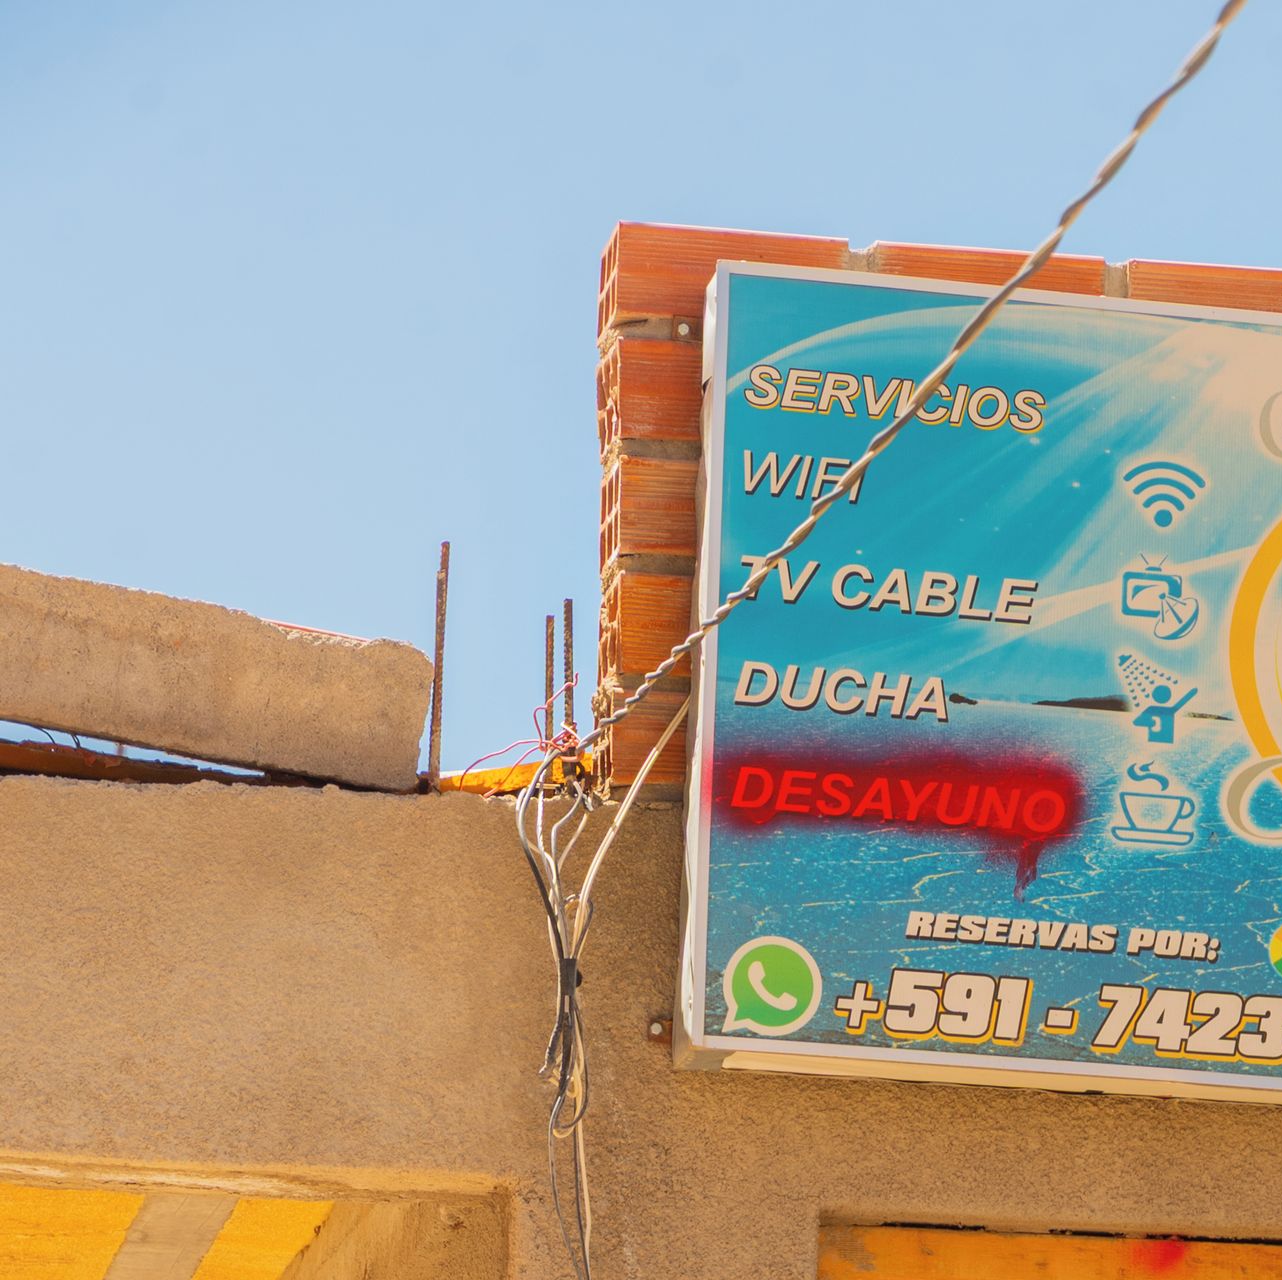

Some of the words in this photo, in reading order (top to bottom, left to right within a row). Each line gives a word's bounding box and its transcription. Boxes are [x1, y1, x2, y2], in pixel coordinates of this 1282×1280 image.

[744, 364, 1047, 432] SERVICIOS
[741, 449, 866, 504] WIFI
[738, 555, 821, 605] TV
[832, 563, 1038, 625] CABLE
[734, 661, 951, 722] DUCHA
[730, 766, 1068, 835] DESAYUNO
[905, 911, 1119, 955] RESERVAS
[1126, 927, 1222, 963] POR:
[834, 968, 1035, 1048] +591
